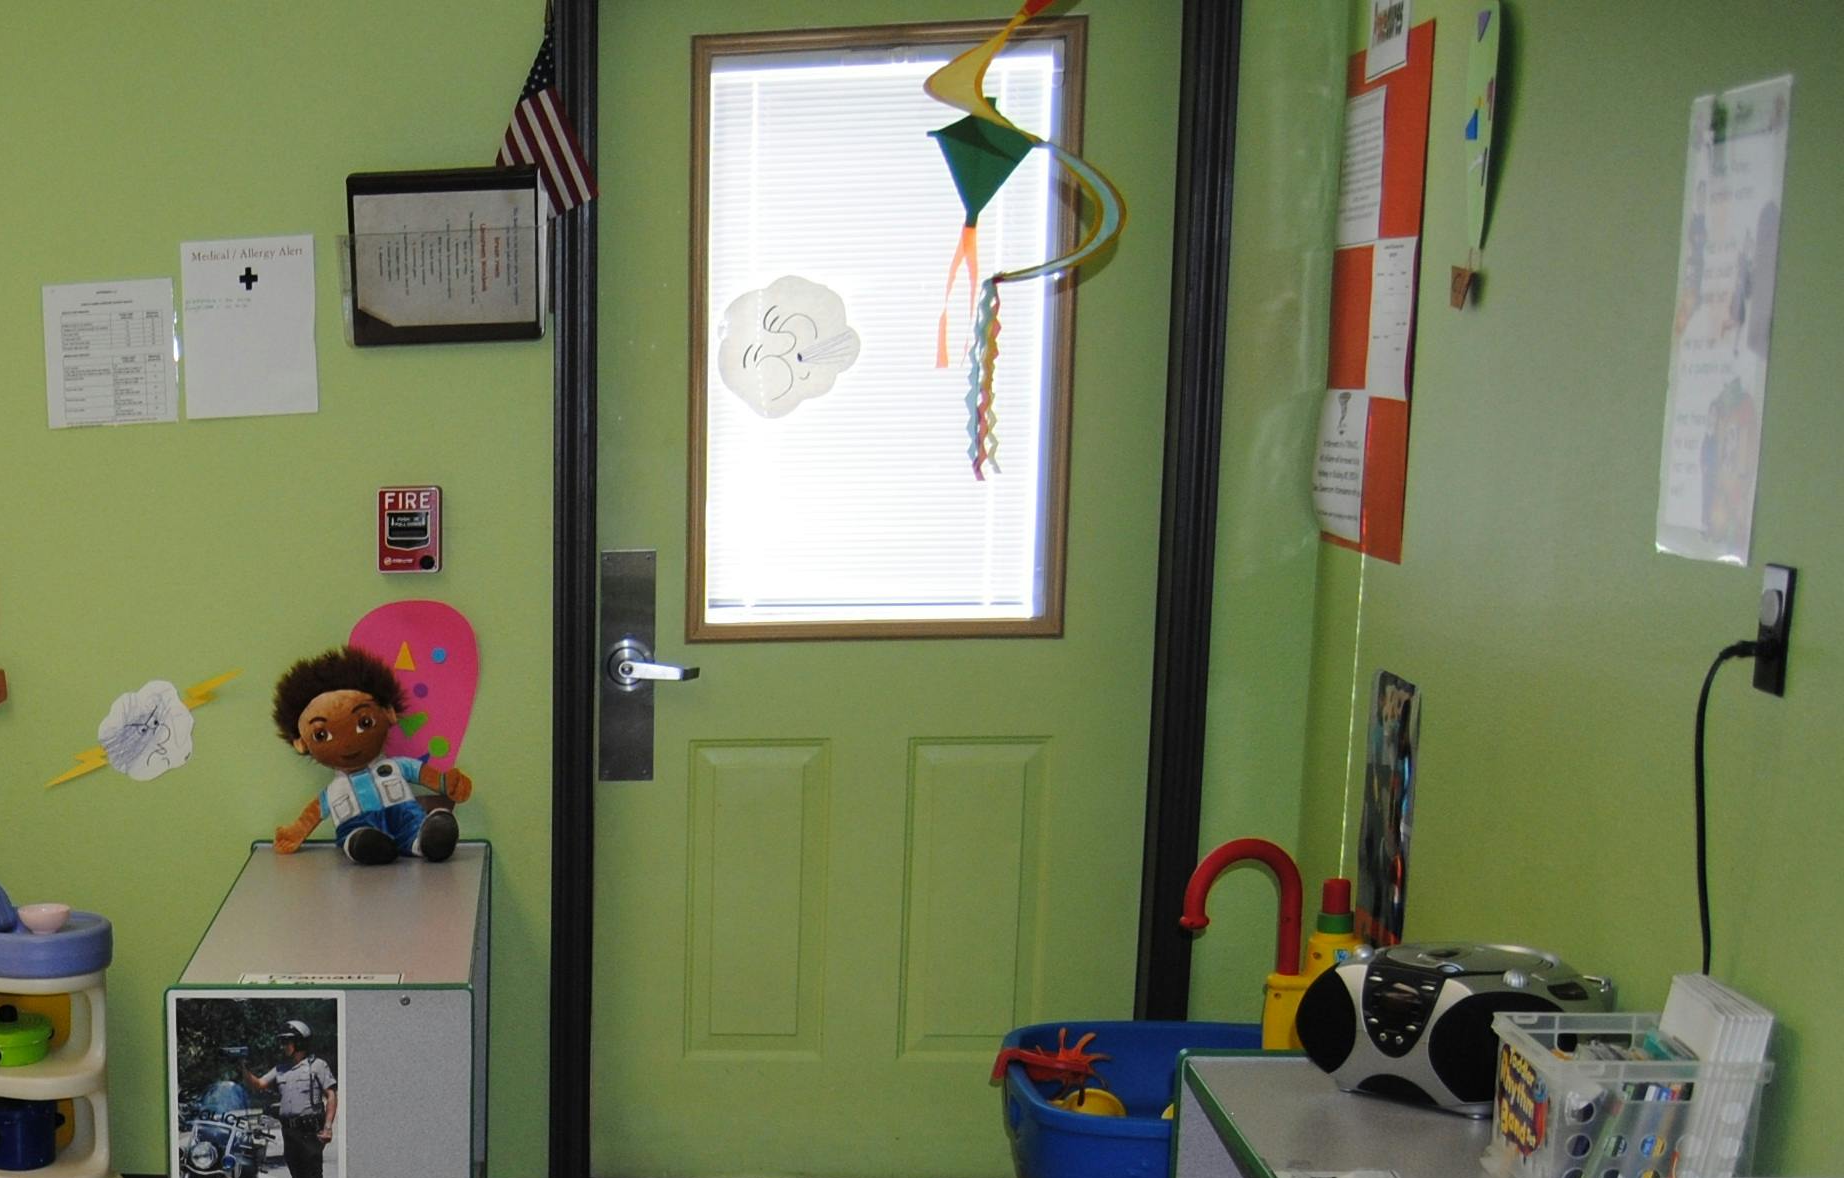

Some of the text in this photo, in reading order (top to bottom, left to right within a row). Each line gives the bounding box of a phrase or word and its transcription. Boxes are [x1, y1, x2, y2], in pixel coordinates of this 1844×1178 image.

[191, 249, 230, 263] Medical
[240, 247, 276, 260] Allergy
[279, 245, 303, 257] Alert
[385, 492, 431, 510] FIRE
